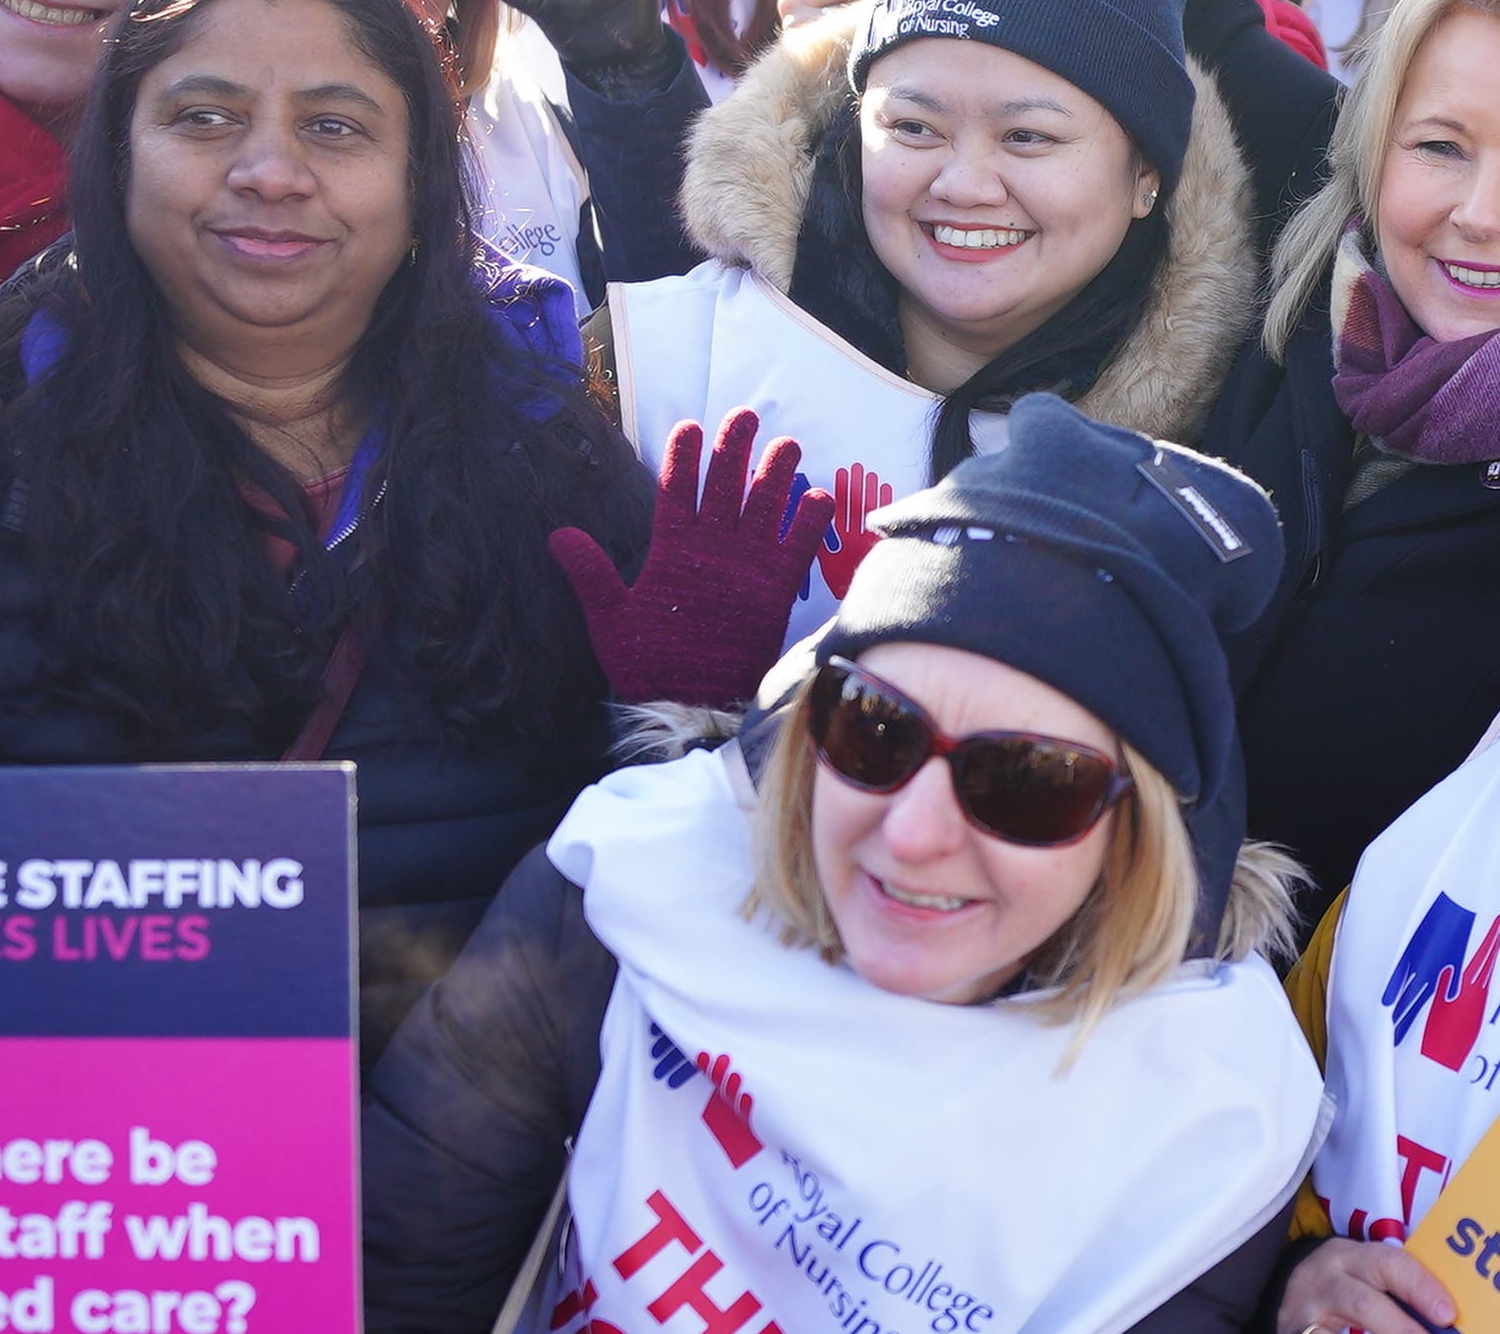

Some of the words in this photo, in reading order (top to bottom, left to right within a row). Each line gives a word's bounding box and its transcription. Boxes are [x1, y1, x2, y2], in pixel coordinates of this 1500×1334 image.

[915, 16, 971, 38] Nursing
[15, 858, 305, 910] STAFFING
[53, 916, 212, 961] LIVES
[128, 1126, 217, 1186] be
[746, 1180, 791, 1229] of
[124, 1202, 320, 1263] when
